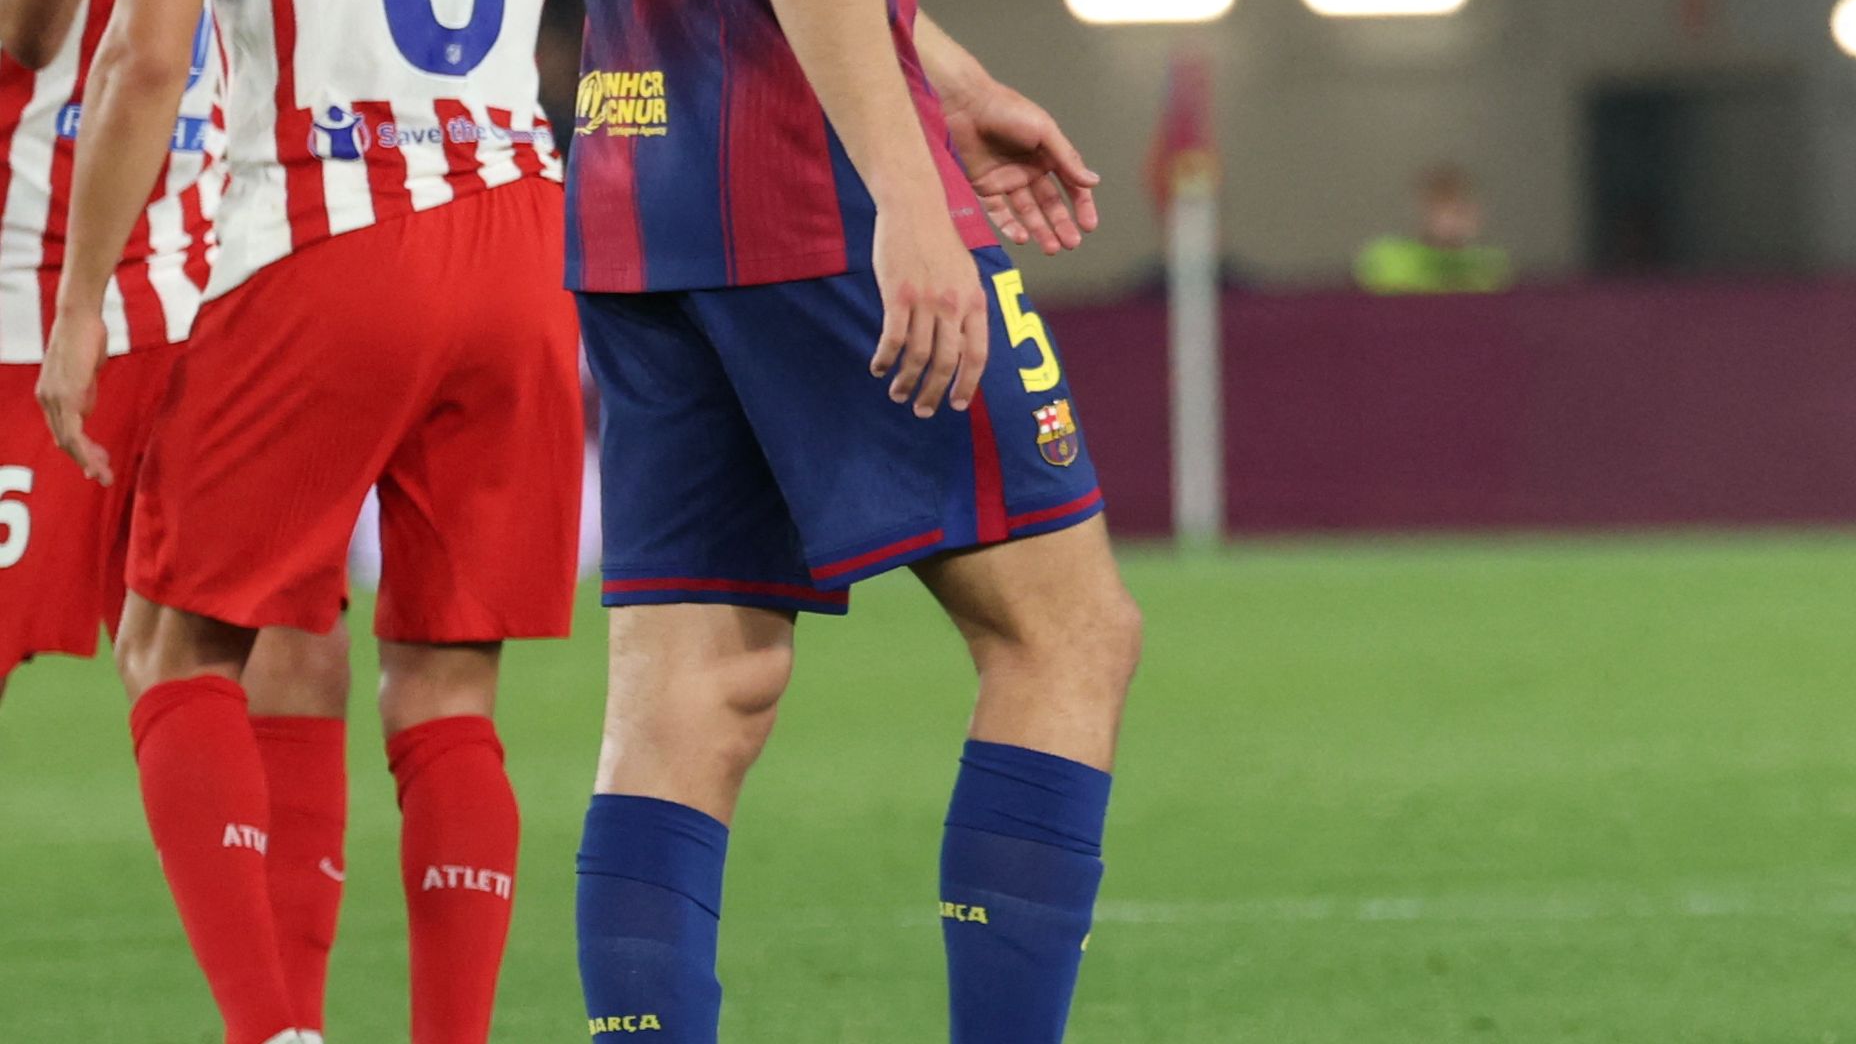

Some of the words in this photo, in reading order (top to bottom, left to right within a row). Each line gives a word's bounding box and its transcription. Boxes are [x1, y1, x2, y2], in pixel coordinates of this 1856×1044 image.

[378, 122, 441, 148] Save
[447, 116, 486, 143] the
[991, 269, 1061, 393] 5
